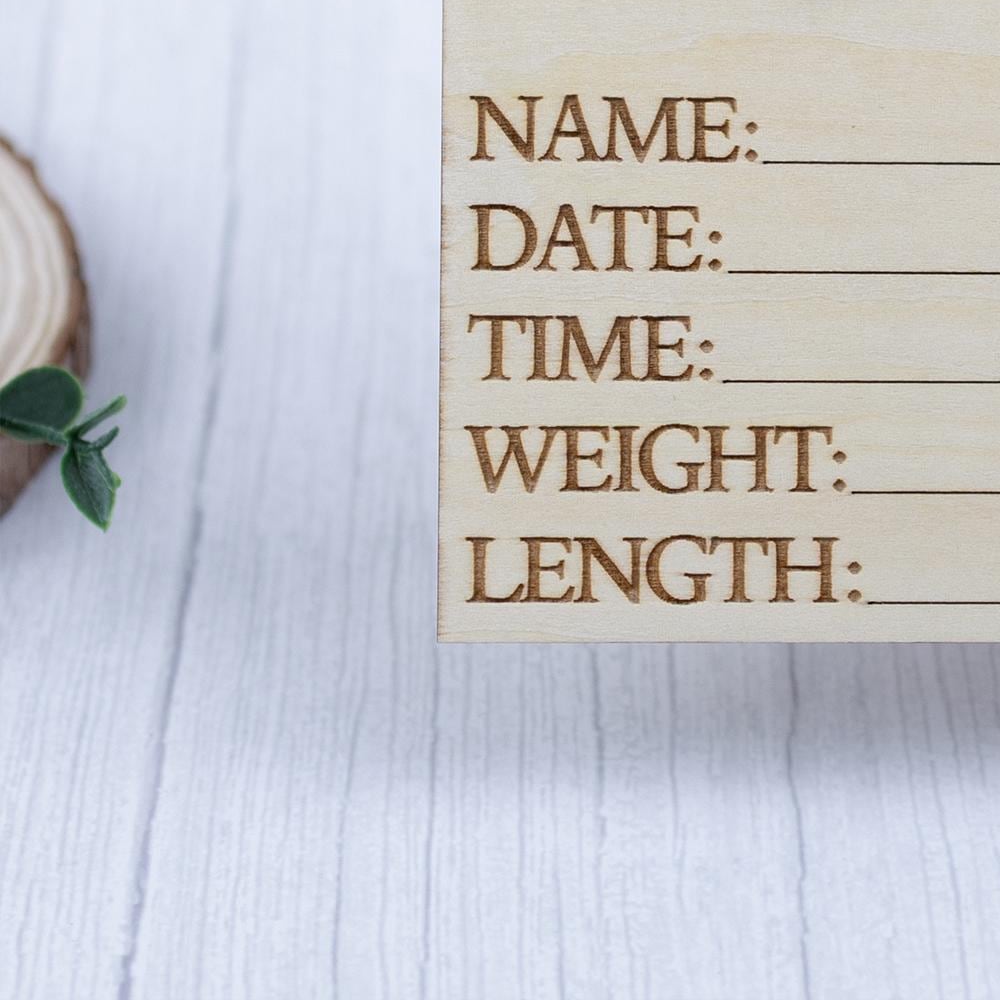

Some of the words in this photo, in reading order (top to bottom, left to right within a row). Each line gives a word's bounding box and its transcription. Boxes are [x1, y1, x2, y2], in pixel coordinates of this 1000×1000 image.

[469, 94, 758, 163] NAME:
[469, 203, 723, 272] DATE:
[467, 313, 714, 382] TIME:
[463, 423, 847, 494] WEIGHT:
[465, 534, 863, 605] LENGTH:
